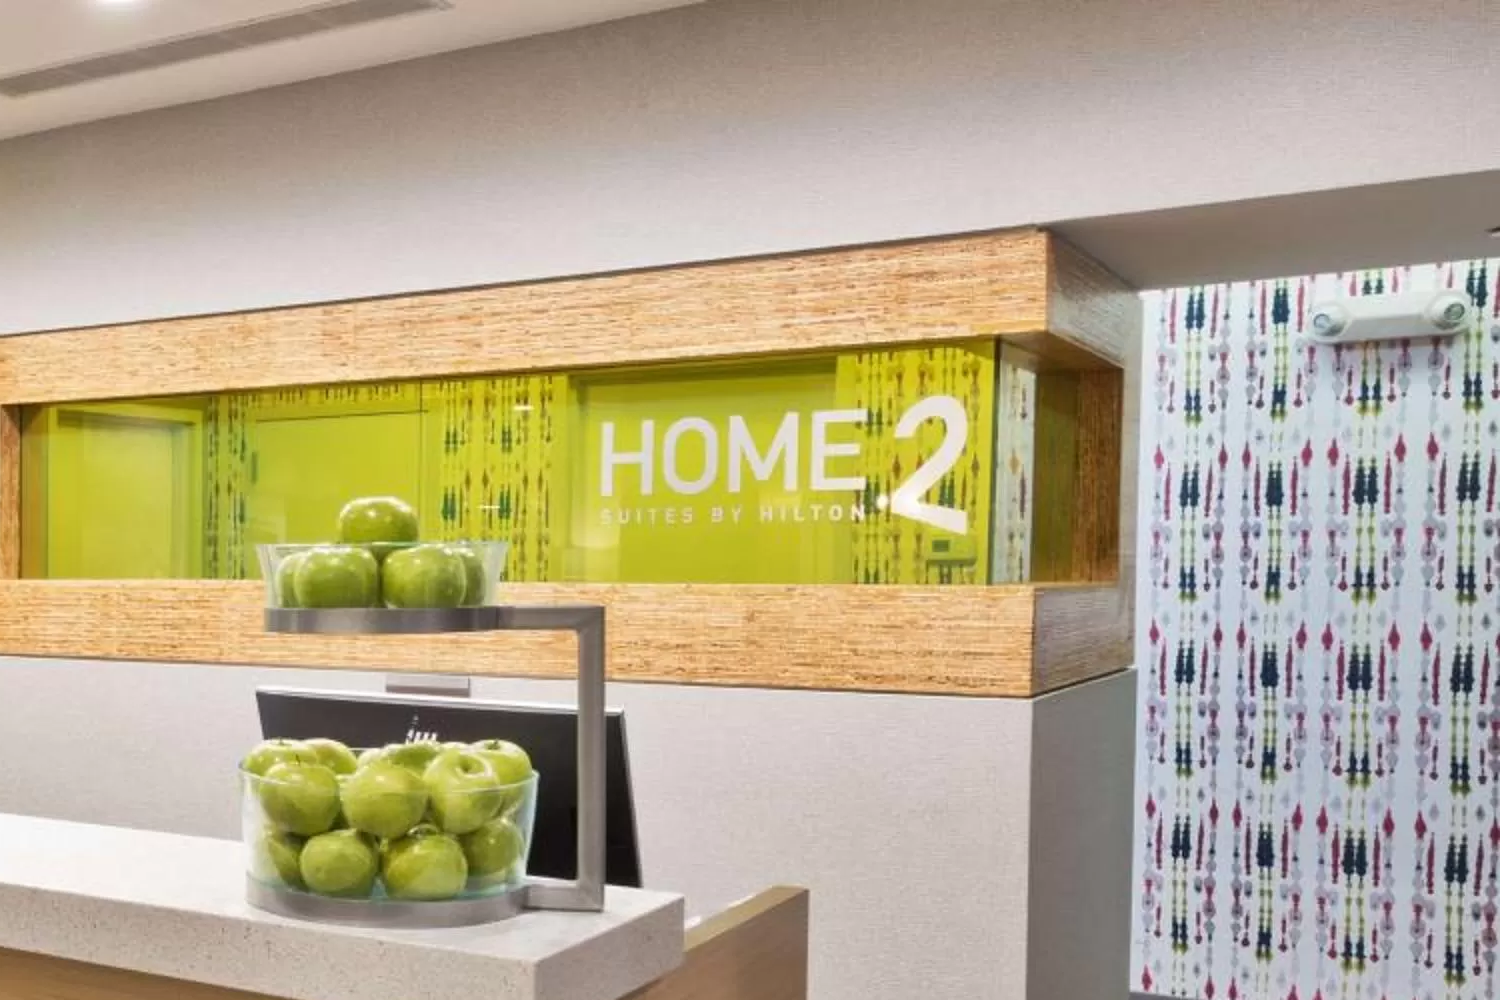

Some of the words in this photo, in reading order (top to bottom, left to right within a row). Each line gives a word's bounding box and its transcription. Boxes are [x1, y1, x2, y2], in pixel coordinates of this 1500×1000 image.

[599, 407, 869, 497] HOME
[890, 394, 968, 537] 2
[600, 506, 694, 527] SUITES
[711, 504, 742, 524] BY
[758, 502, 866, 523] HILTON
